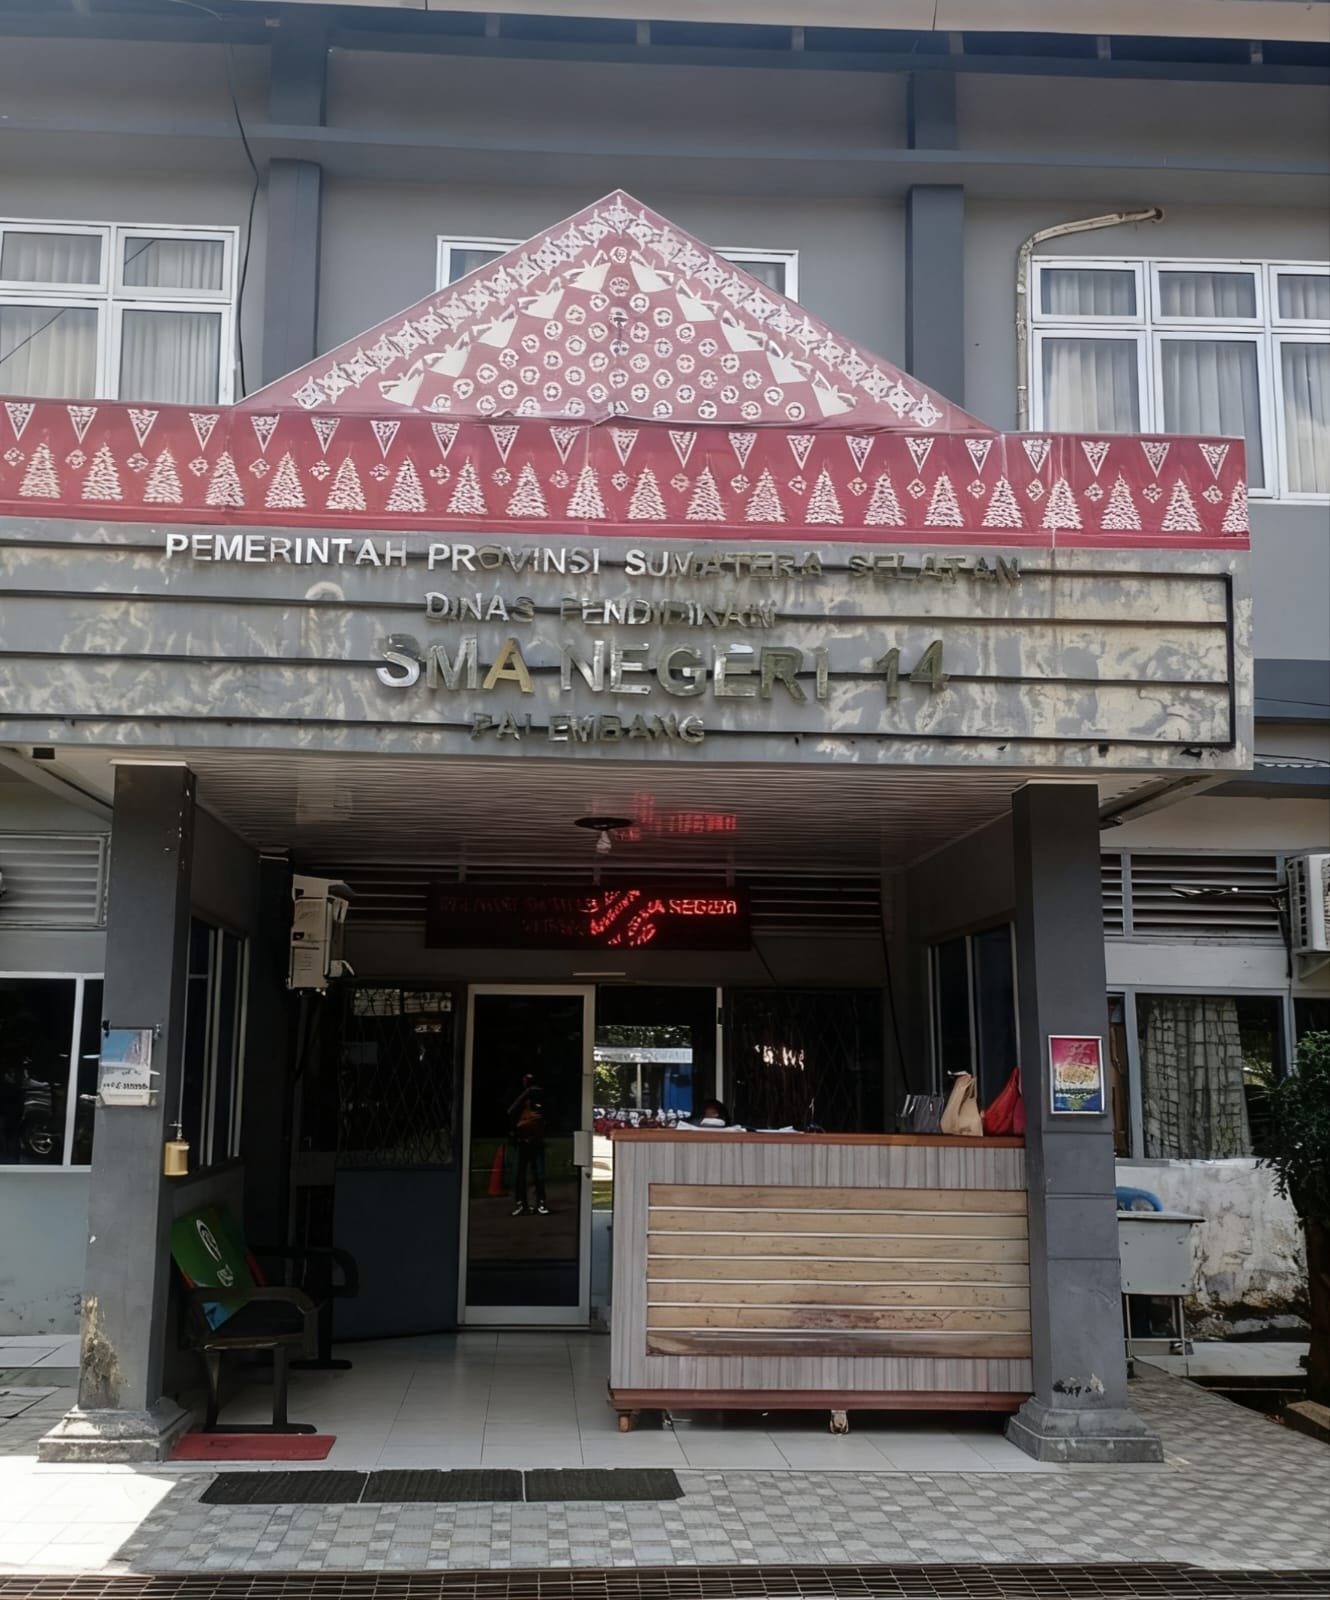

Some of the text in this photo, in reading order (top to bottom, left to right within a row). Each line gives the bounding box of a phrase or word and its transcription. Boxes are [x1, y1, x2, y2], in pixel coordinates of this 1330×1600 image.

[165, 533, 1021, 586] PEMERINTAH PROVINSI SUMATERA SELATAN
[424, 591, 536, 623] DINAS
[375, 633, 950, 702] SMA NEGERI 14
